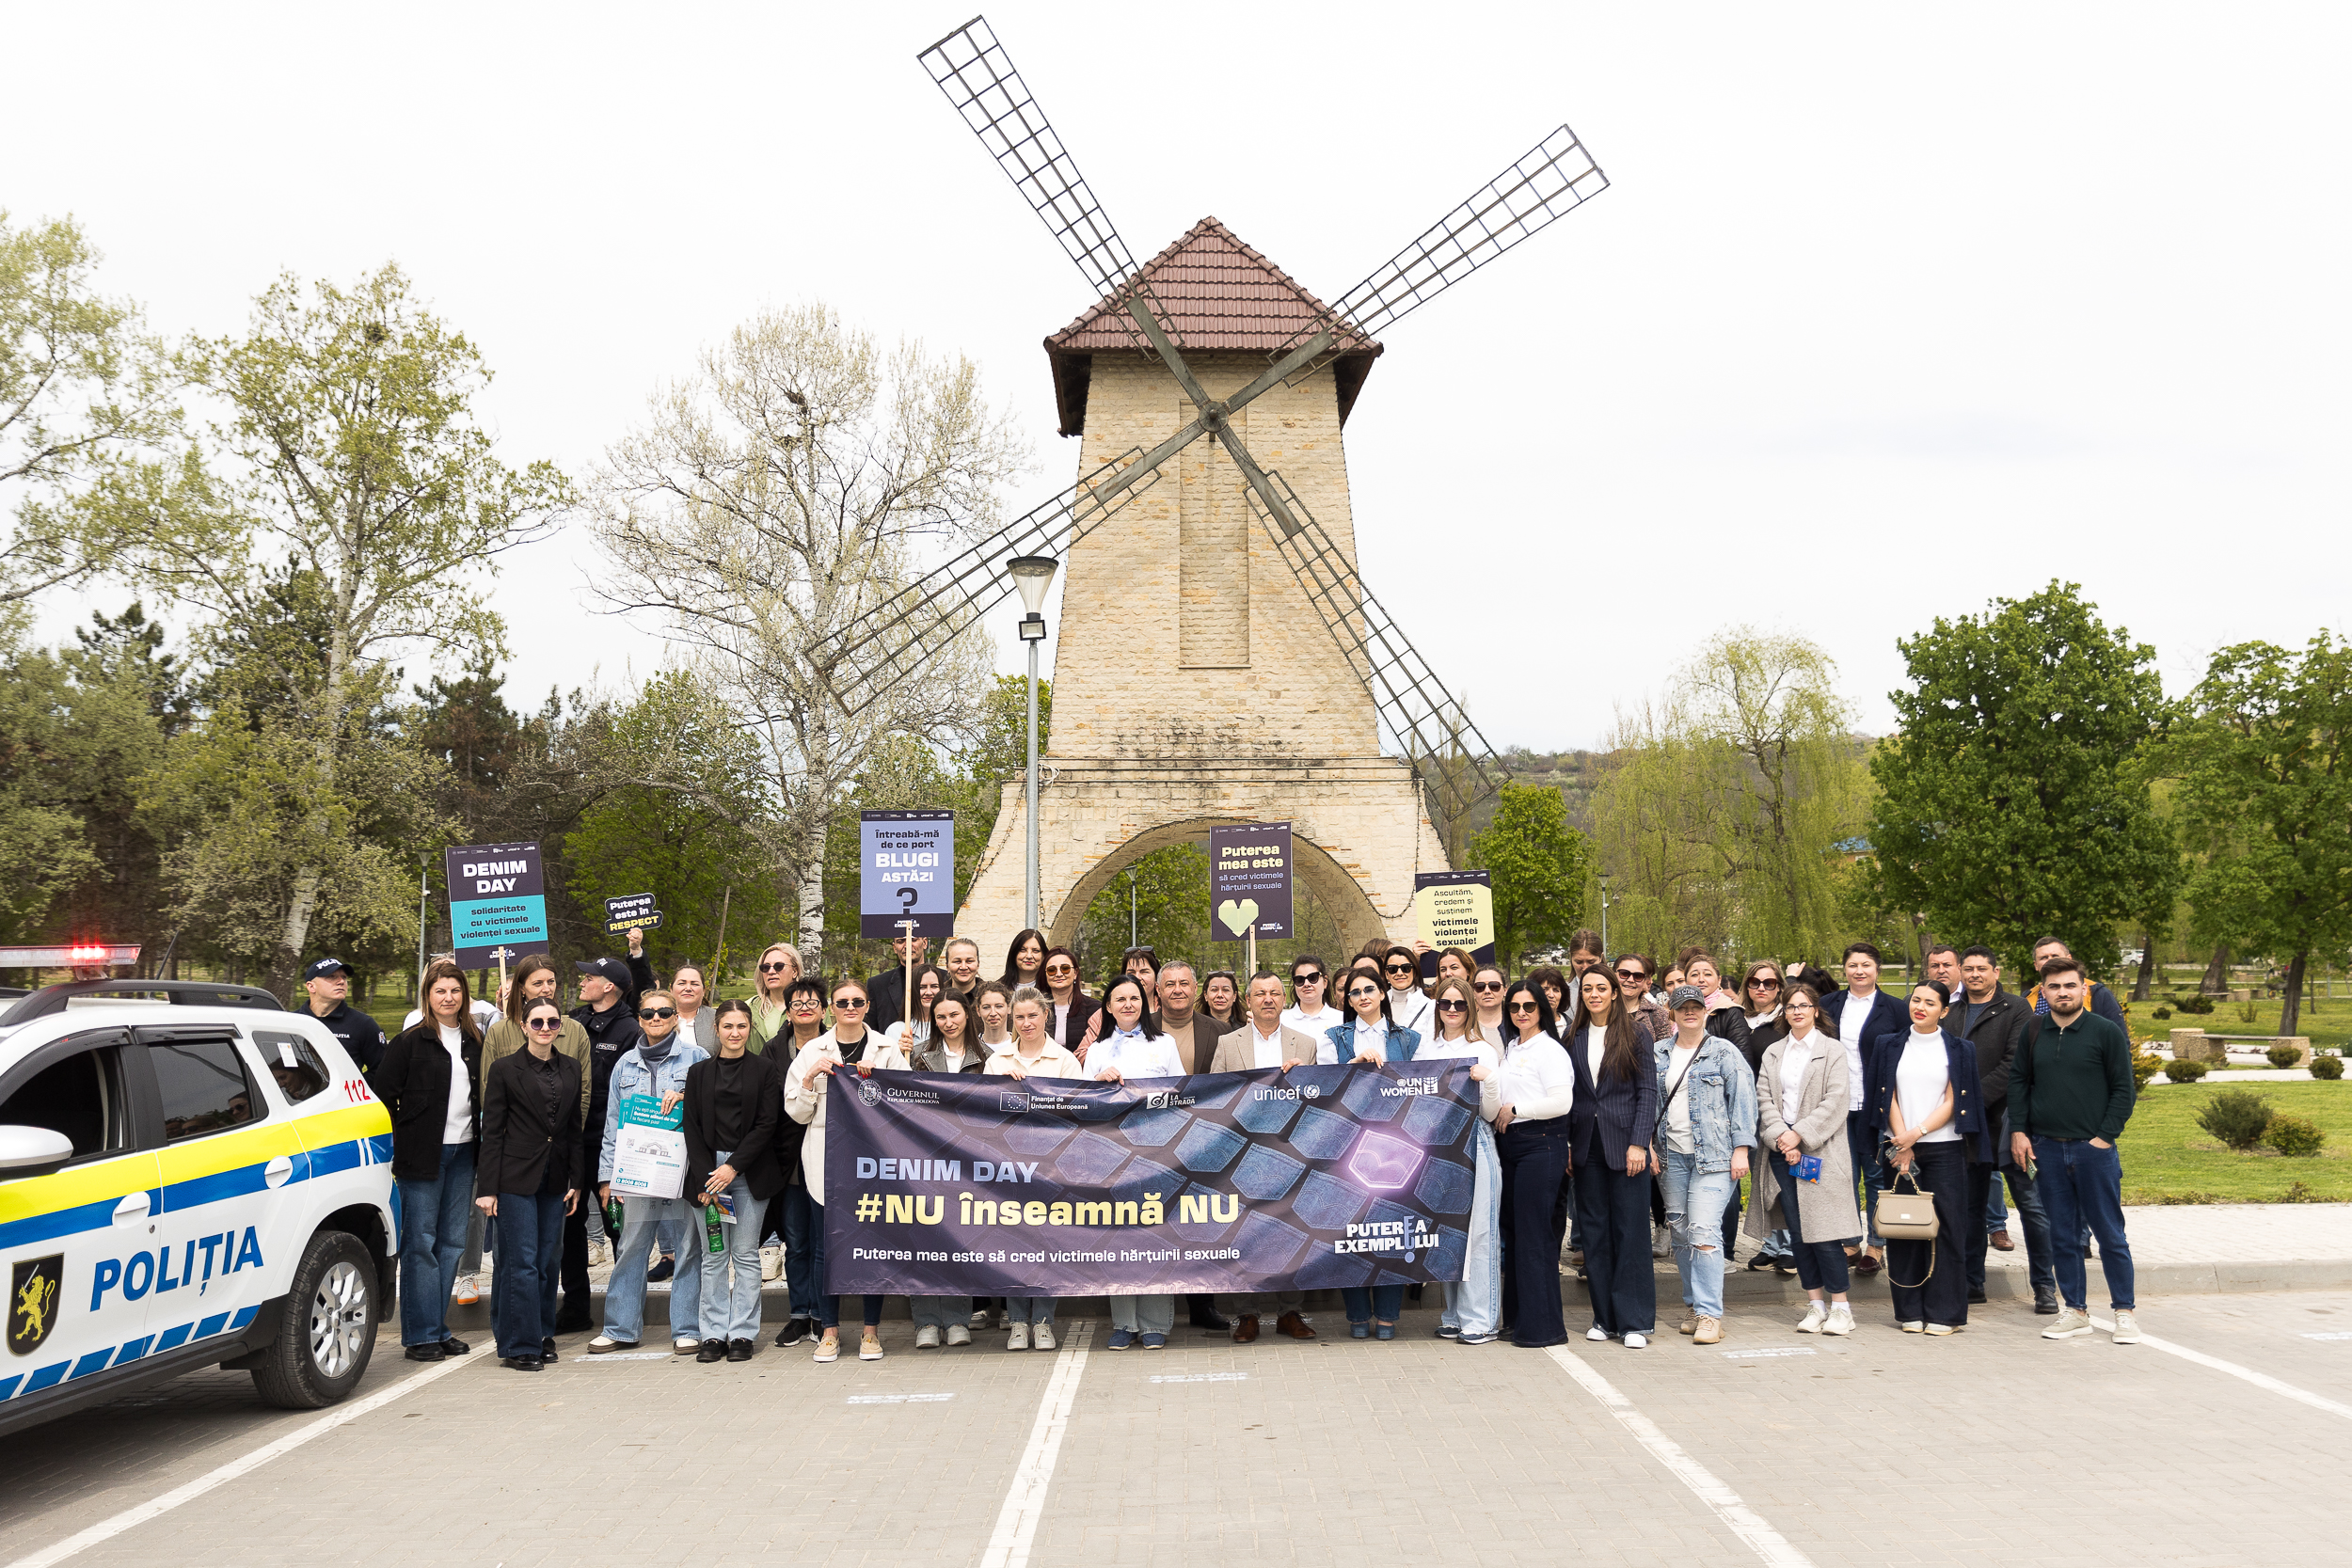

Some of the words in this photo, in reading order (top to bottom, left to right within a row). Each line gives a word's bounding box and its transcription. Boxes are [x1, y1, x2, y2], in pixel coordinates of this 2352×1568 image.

[875, 830, 940, 838] Întreabă-mă
[912, 841, 934, 849] port
[1221, 846, 1280, 858] Puterea
[875, 852, 939, 868] BLUGI
[1218, 859, 1249, 871] mea
[1252, 857, 1284, 868] este
[463, 860, 527, 878] DENIM
[882, 869, 933, 883] ASTĂZI
[476, 878, 516, 894] DAY
[1252, 881, 1282, 890] sexuale
[470, 904, 526, 915] solidaritate
[610, 897, 651, 911] Puterea
[485, 915, 529, 927] victimele
[615, 910, 637, 920] este
[610, 915, 659, 931] RESPECT
[1432, 917, 1479, 927] victimele
[460, 928, 501, 939] violenței
[504, 926, 540, 936] sexuale
[1434, 927, 1478, 936] violenței
[1436, 937, 1477, 946] sexuale!
[1407, 1078, 1422, 1087] UN
[344, 1080, 371, 1102] 112
[887, 1087, 940, 1100] GUVERNUL
[1254, 1085, 1301, 1101] unicef
[1379, 1087, 1423, 1098] WOMEN
[1169, 1098, 1196, 1106] STRADA
[856, 1156, 961, 1181] DENIM
[973, 1161, 1040, 1183] DAY
[855, 1193, 945, 1226] #NU
[959, 1191, 1164, 1226] înseamnă
[1180, 1194, 1239, 1224] NU
[1346, 1216, 1427, 1238] PUTEREA
[1334, 1234, 1438, 1254] EXEMPLULUI
[852, 1247, 913, 1260] Puterea
[916, 1250, 948, 1261] mea
[952, 1251, 984, 1262] este
[988, 1250, 1006, 1262] să
[1009, 1250, 1045, 1262] cred
[1049, 1250, 1116, 1262] victimele
[1120, 1248, 1180, 1263] hărțuirii
[1184, 1247, 1241, 1260] sexuale
[89, 1226, 264, 1312] POLIȚIA
